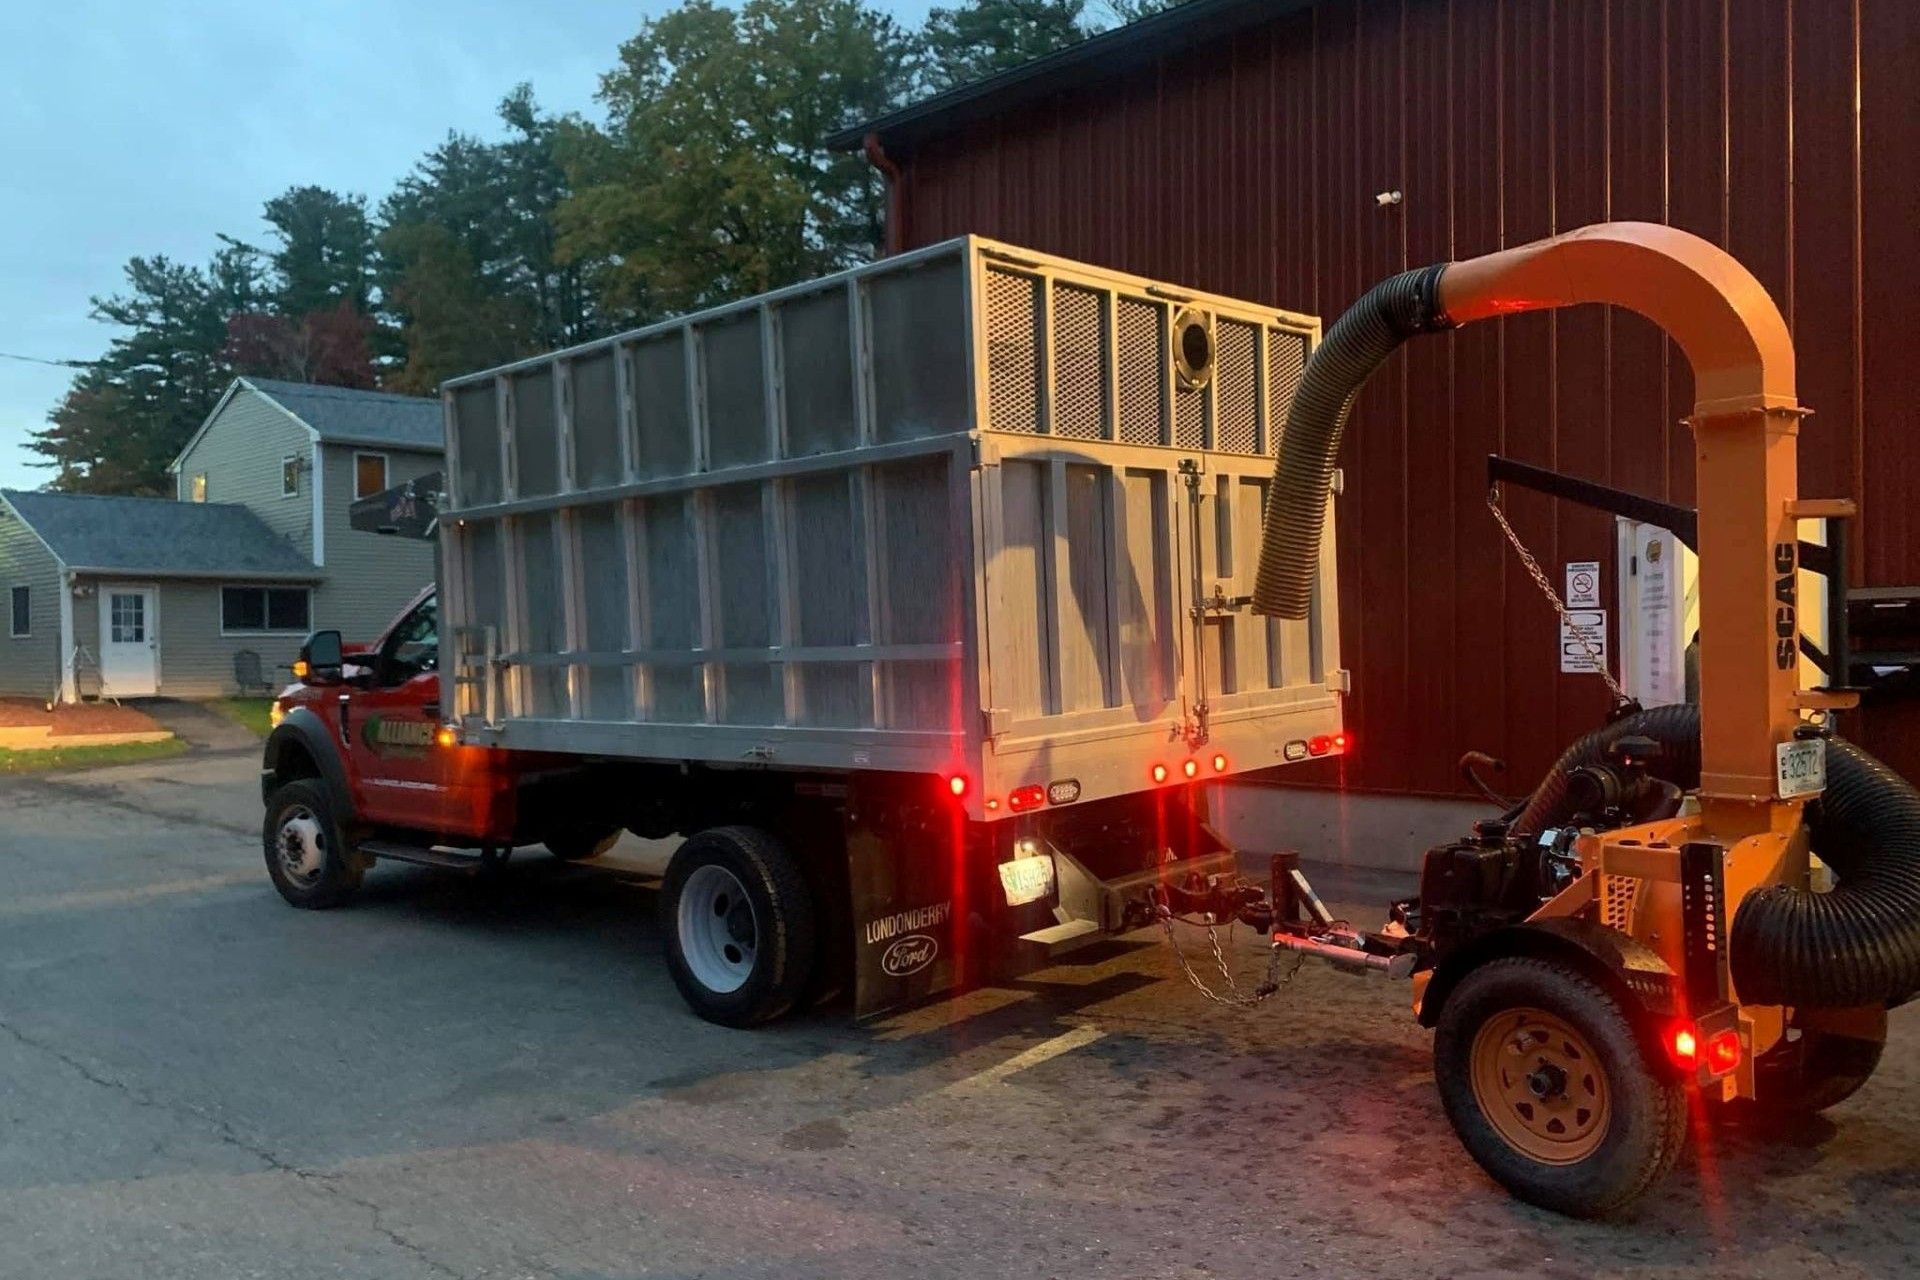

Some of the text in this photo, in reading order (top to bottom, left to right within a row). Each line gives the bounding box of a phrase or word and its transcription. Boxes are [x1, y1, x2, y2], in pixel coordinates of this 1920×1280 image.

[1774, 543, 1796, 670] SCAG
[865, 900, 951, 944] LONDONDERRY
[889, 941, 931, 971] Ford
